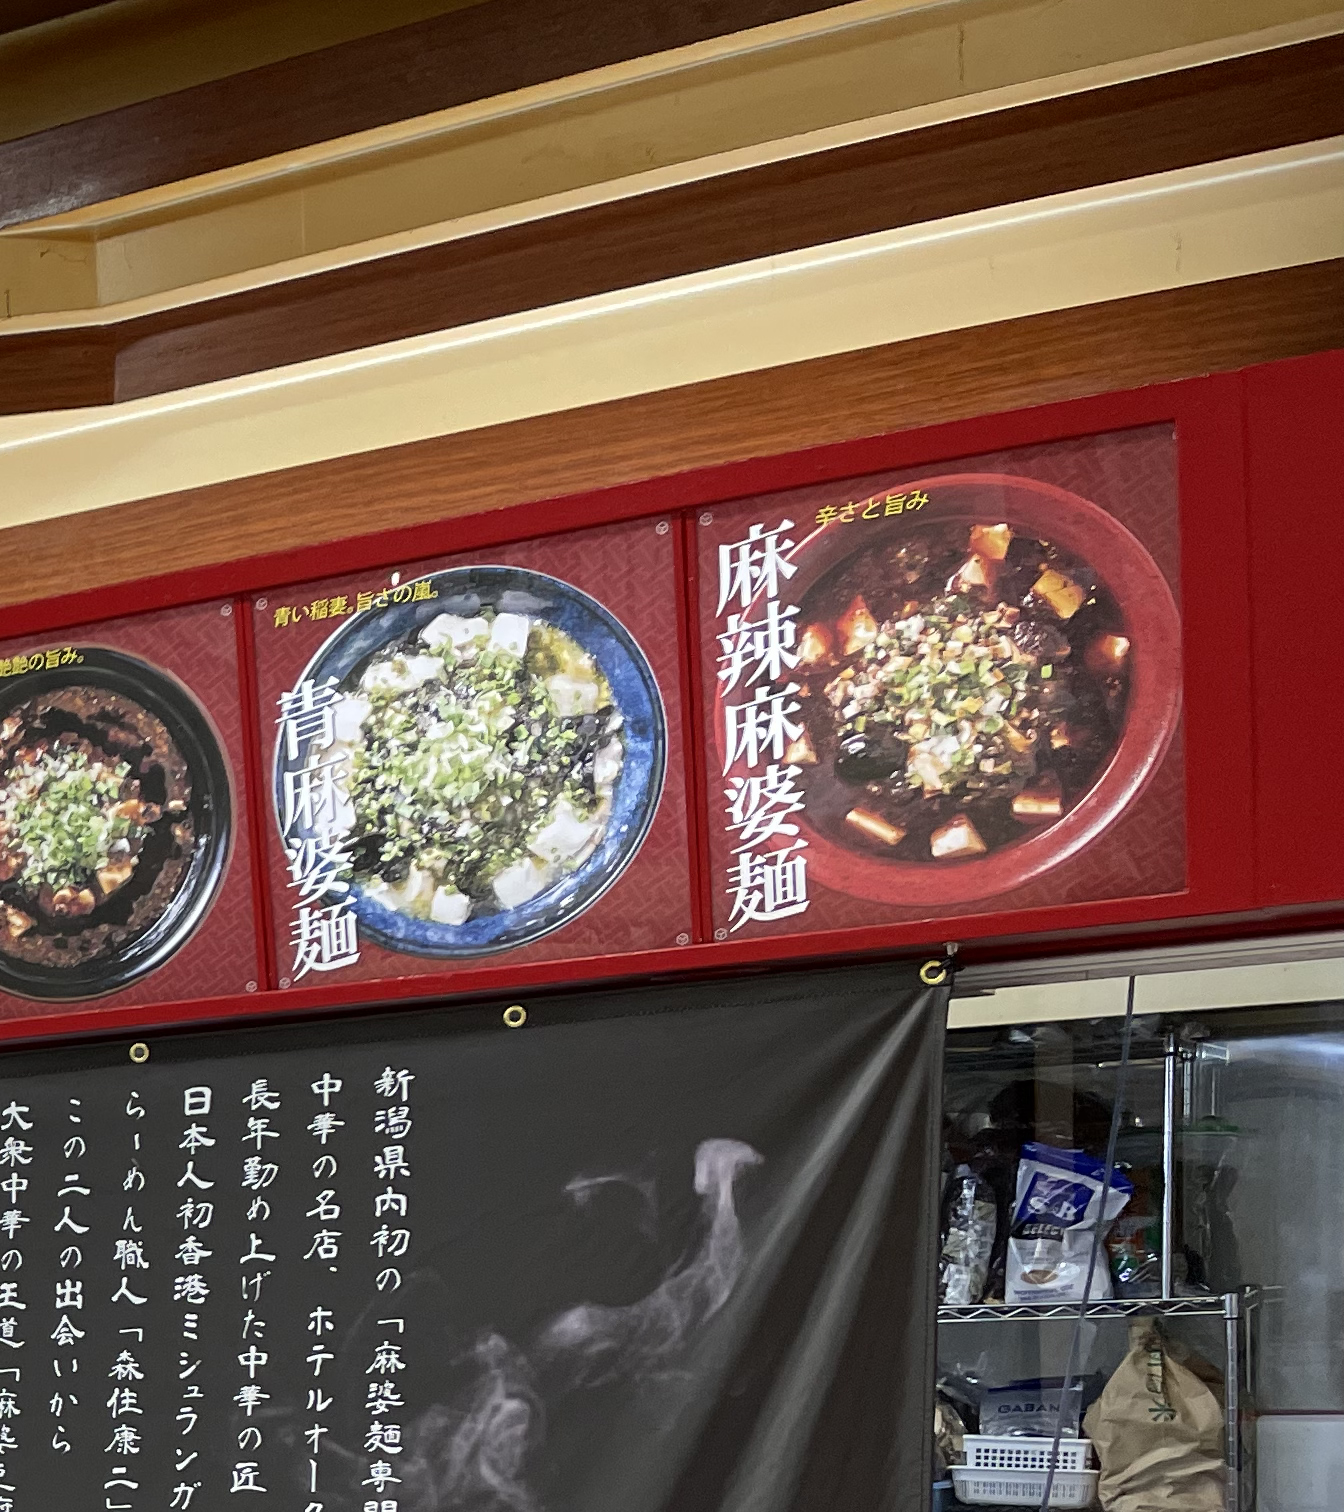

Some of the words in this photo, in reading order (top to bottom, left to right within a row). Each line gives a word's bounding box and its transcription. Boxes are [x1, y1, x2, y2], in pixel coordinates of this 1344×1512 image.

[815, 490, 929, 527] 辛さと旨み
[273, 580, 438, 628] 青い稲妻。旨さの嵐。
[714, 519, 810, 933] 麻辣麻婆麺
[275, 676, 360, 982] 青麻婆麺
[49, 1099, 90, 1455] この二人の出会いから
[997, 1402, 1061, 1414] GABAN
